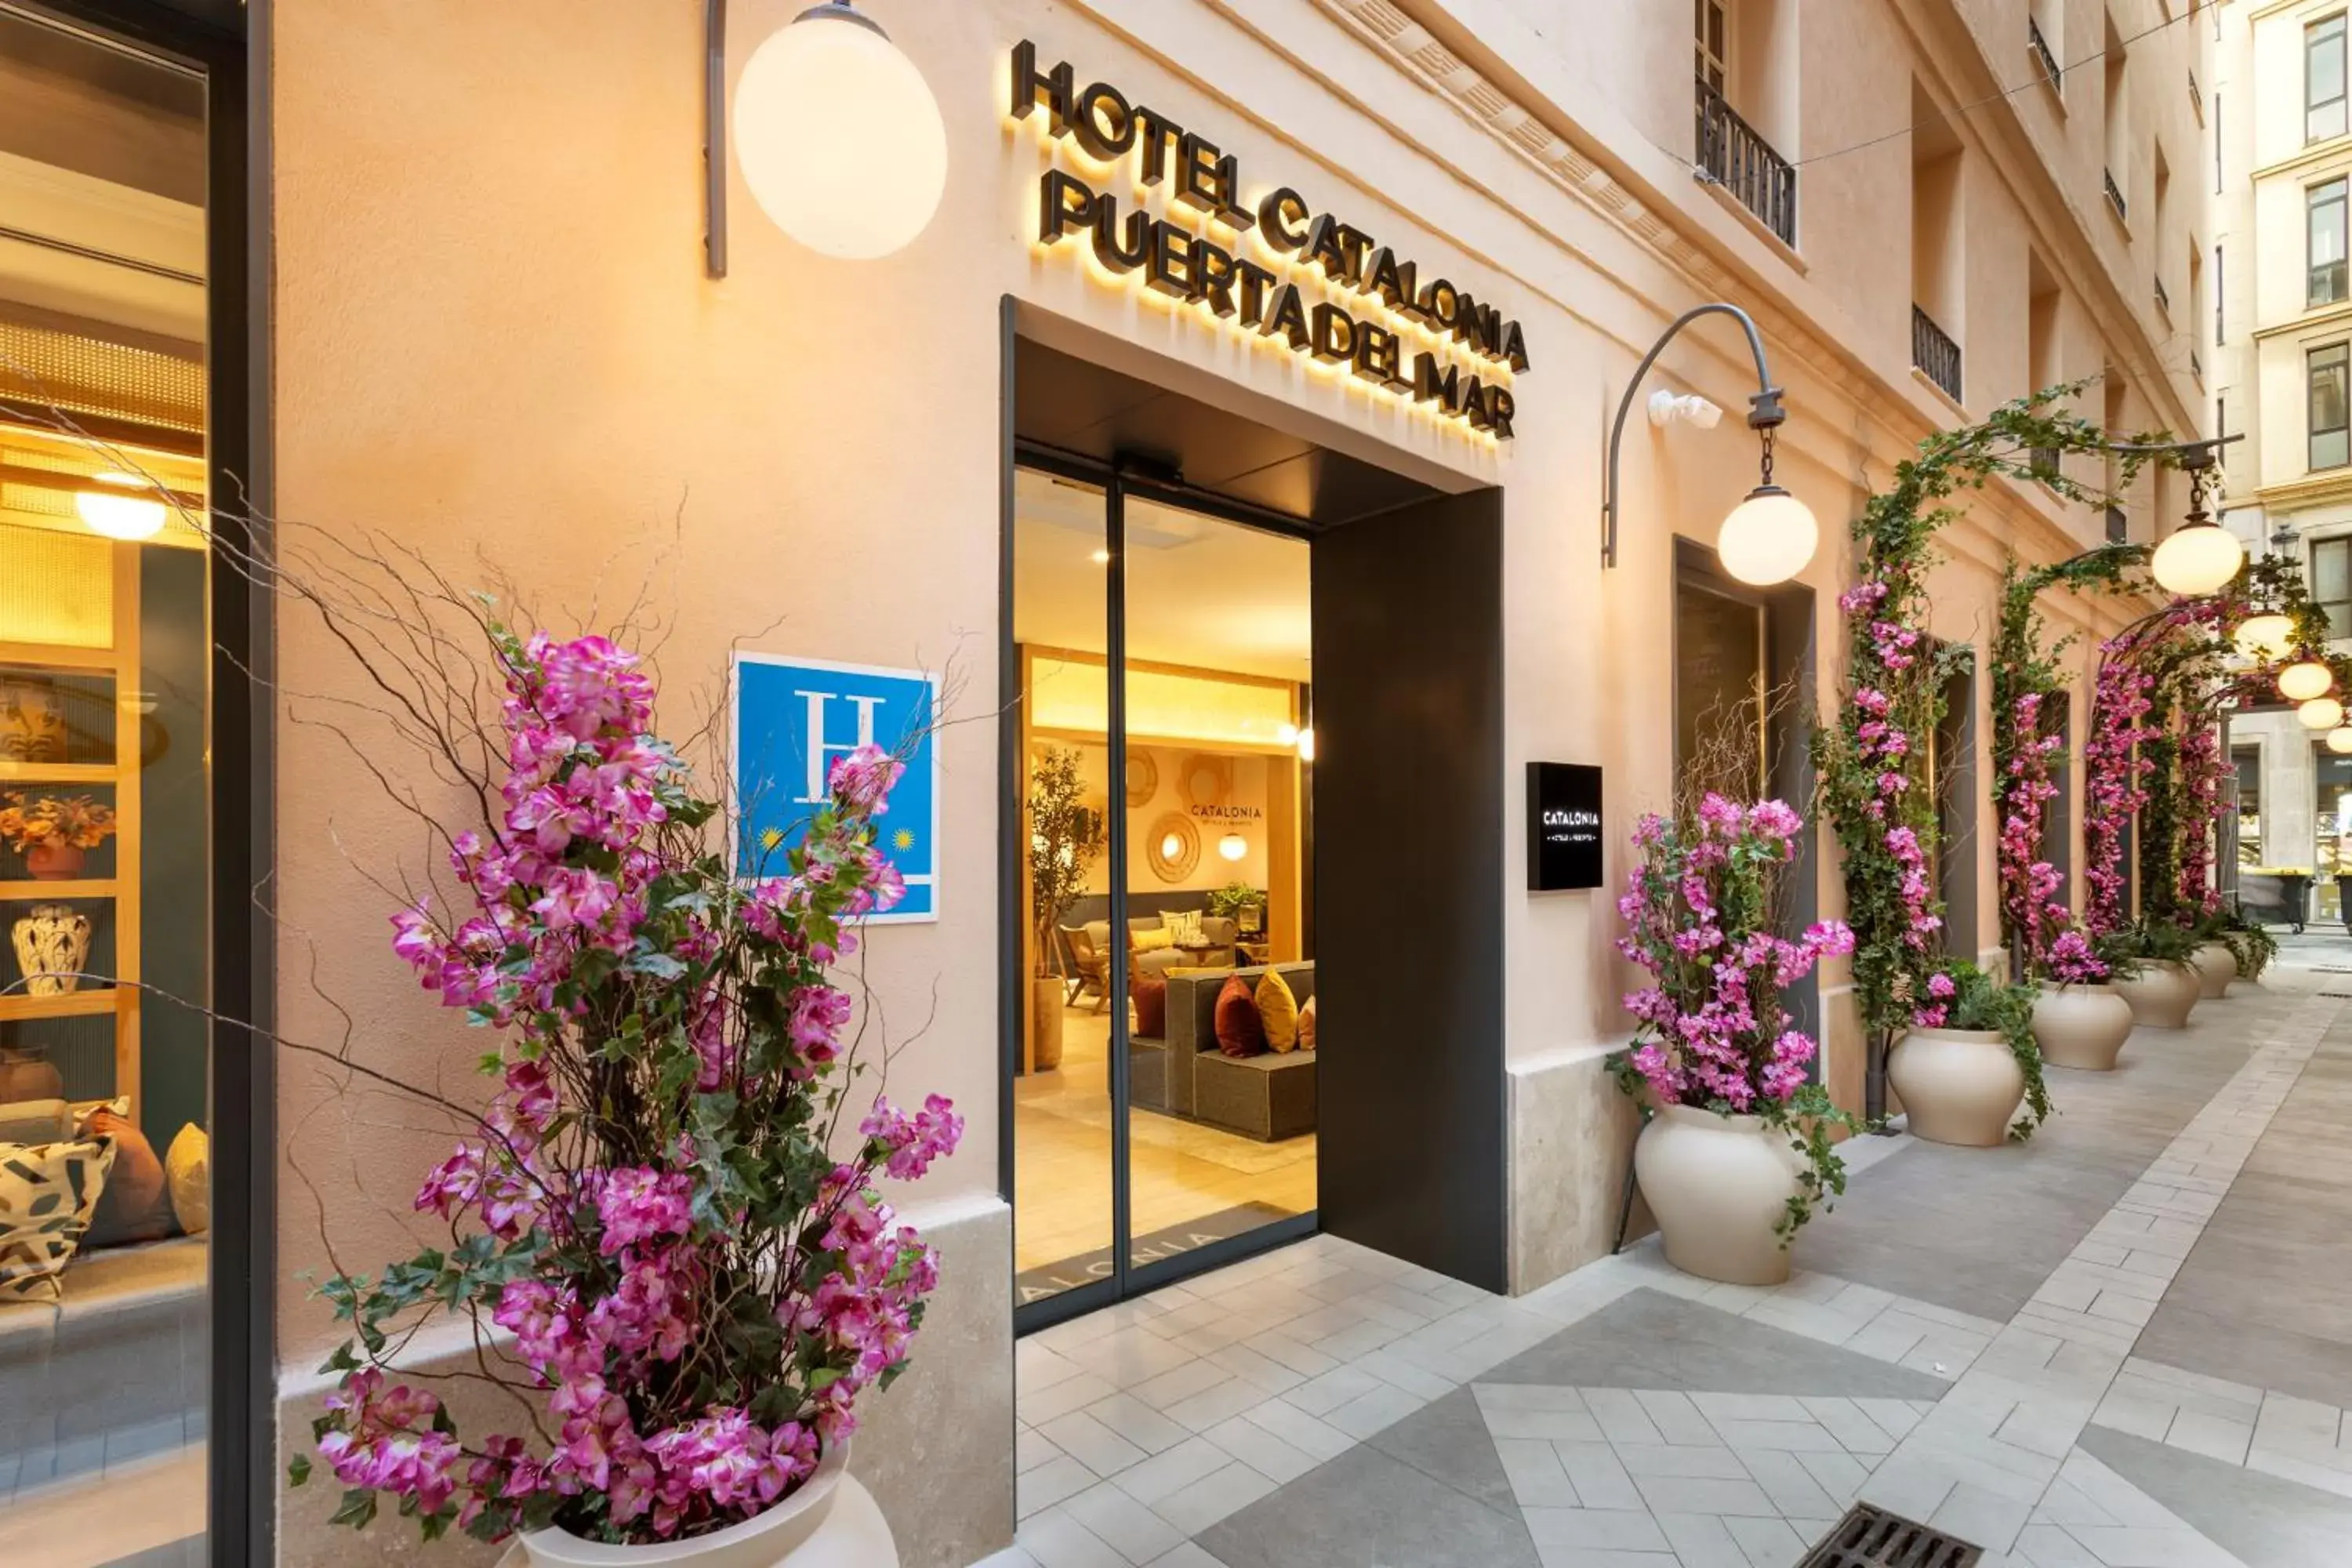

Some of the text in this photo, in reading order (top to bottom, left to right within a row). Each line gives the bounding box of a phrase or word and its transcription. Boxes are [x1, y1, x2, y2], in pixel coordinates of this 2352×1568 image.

[1011, 39, 1530, 374] HOTEL CATALONIA
[1040, 169, 1515, 440] PUERTA DEL MAR
[1191, 804, 1261, 818] CATALONIA
[1543, 811, 1599, 826] CATALONIA
